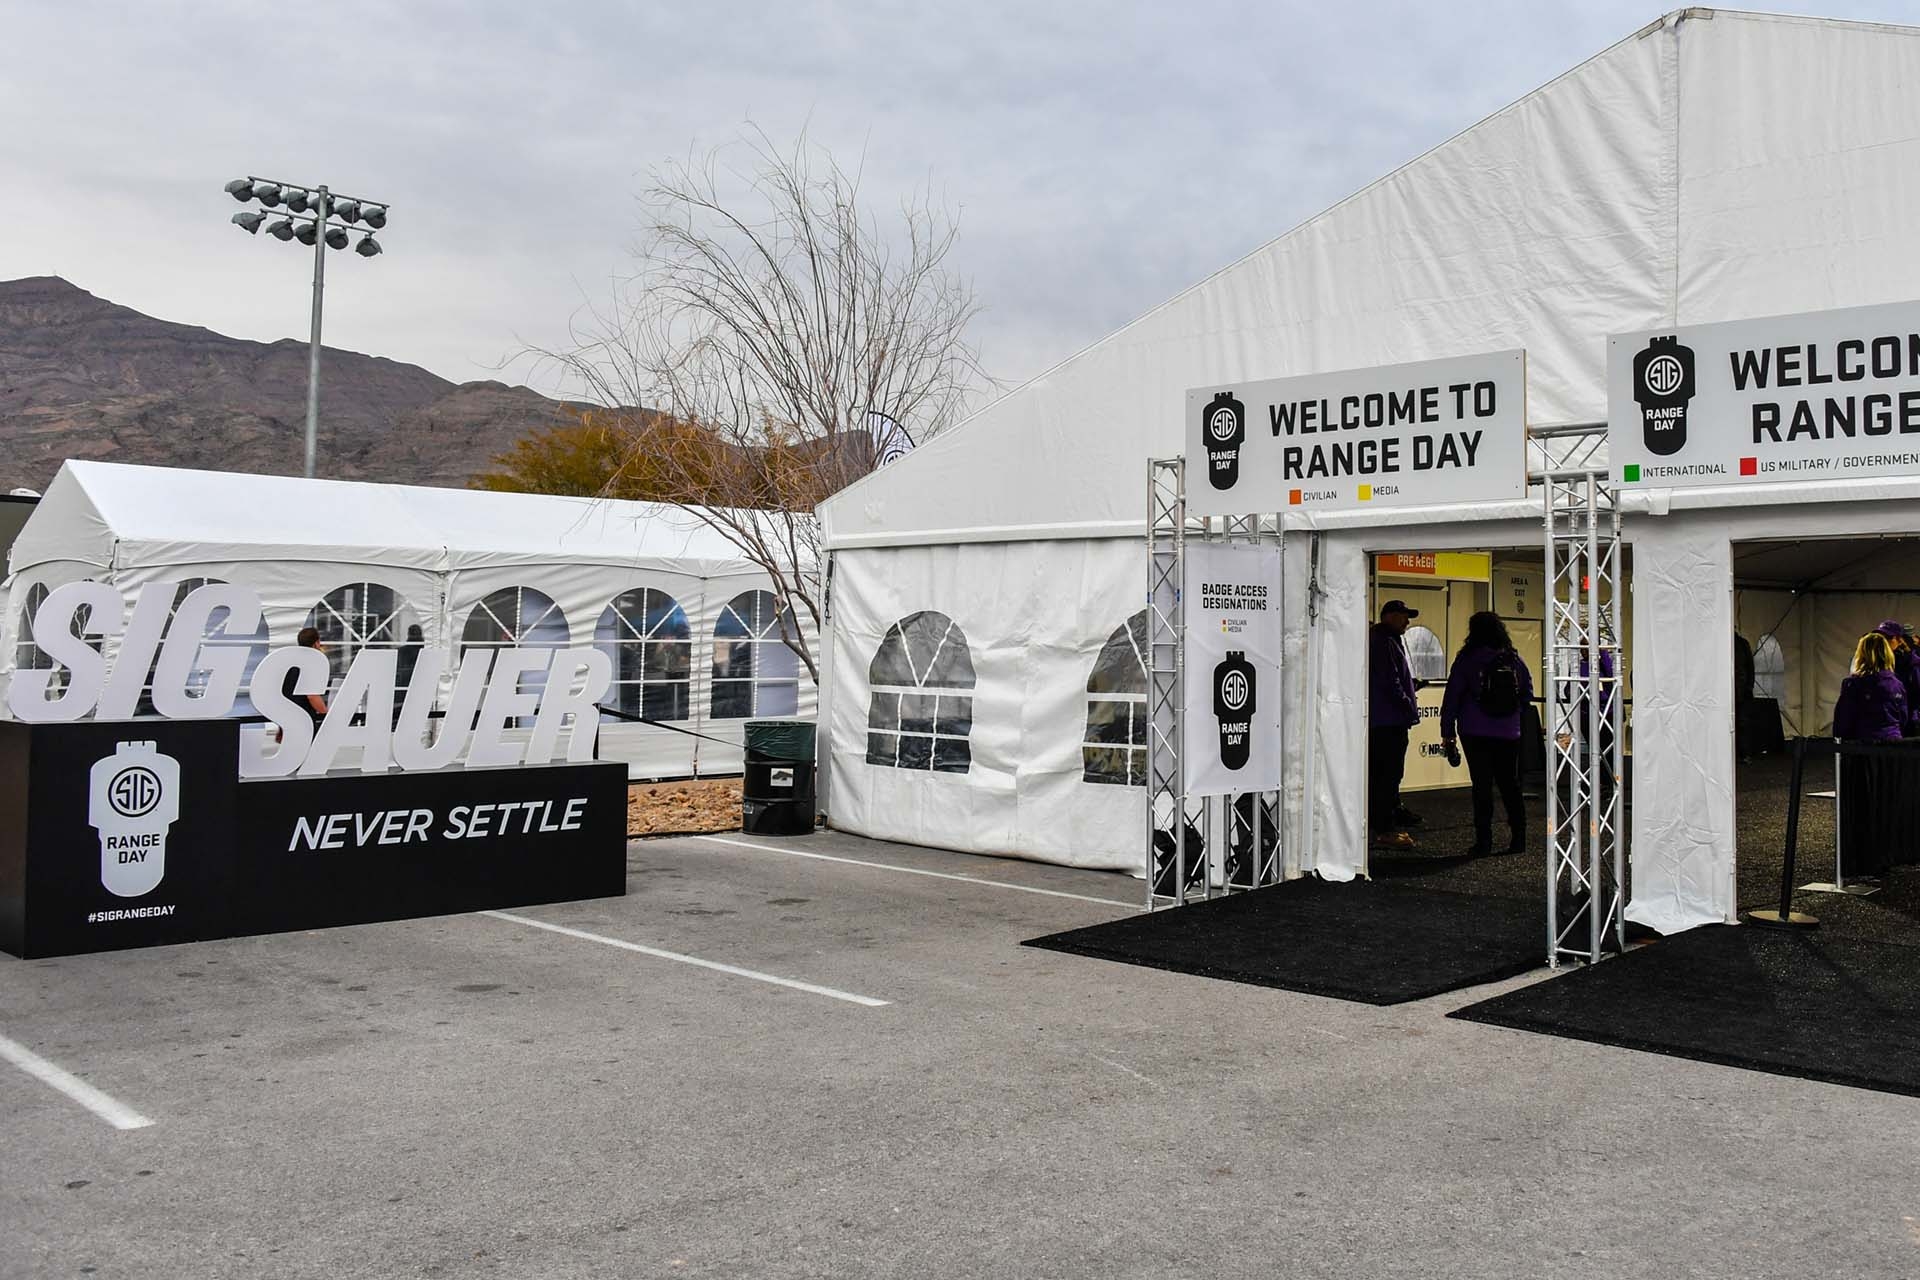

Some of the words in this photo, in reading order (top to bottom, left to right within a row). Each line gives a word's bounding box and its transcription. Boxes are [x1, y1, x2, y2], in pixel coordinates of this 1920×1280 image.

[1650, 358, 1680, 392] SIG
[1269, 387, 1439, 437] WELCOME
[1449, 381, 1496, 418] TO
[1646, 406, 1684, 420] RANGE
[1753, 391, 1920, 443] RANGE
[1213, 411, 1234, 437] SIG
[1654, 418, 1676, 431] DAY
[1210, 450, 1237, 461] RANGE
[1283, 438, 1400, 480] RANGE
[1413, 430, 1483, 470] DAY
[1216, 460, 1231, 470] DAY
[1643, 462, 1727, 478] INTERNATIONAL
[1760, 461, 1776, 473] US
[1779, 457, 1831, 472] MILITARY
[1303, 490, 1338, 502] CIVILIAN
[1373, 485, 1400, 497] MEDIA
[1398, 554, 1415, 567] PRE
[1202, 583, 1232, 596] BADGE
[1234, 584, 1267, 597] ACCESS
[1514, 588, 1526, 597] EXIT
[1203, 597, 1267, 610] DESIGNATIONS
[8, 581, 264, 722] SIG
[1225, 675, 1245, 704] SIG
[239, 646, 612, 779] SAUER
[1222, 722, 1248, 734] RANGE
[1227, 734, 1243, 745] DAY
[115, 773, 155, 811] SIG
[288, 809, 434, 852] NEVER
[442, 798, 588, 840] SETTLE
[107, 833, 161, 850] RANGE
[118, 850, 148, 865] DAY
[88, 904, 176, 922] #SIGRANGEDAY
